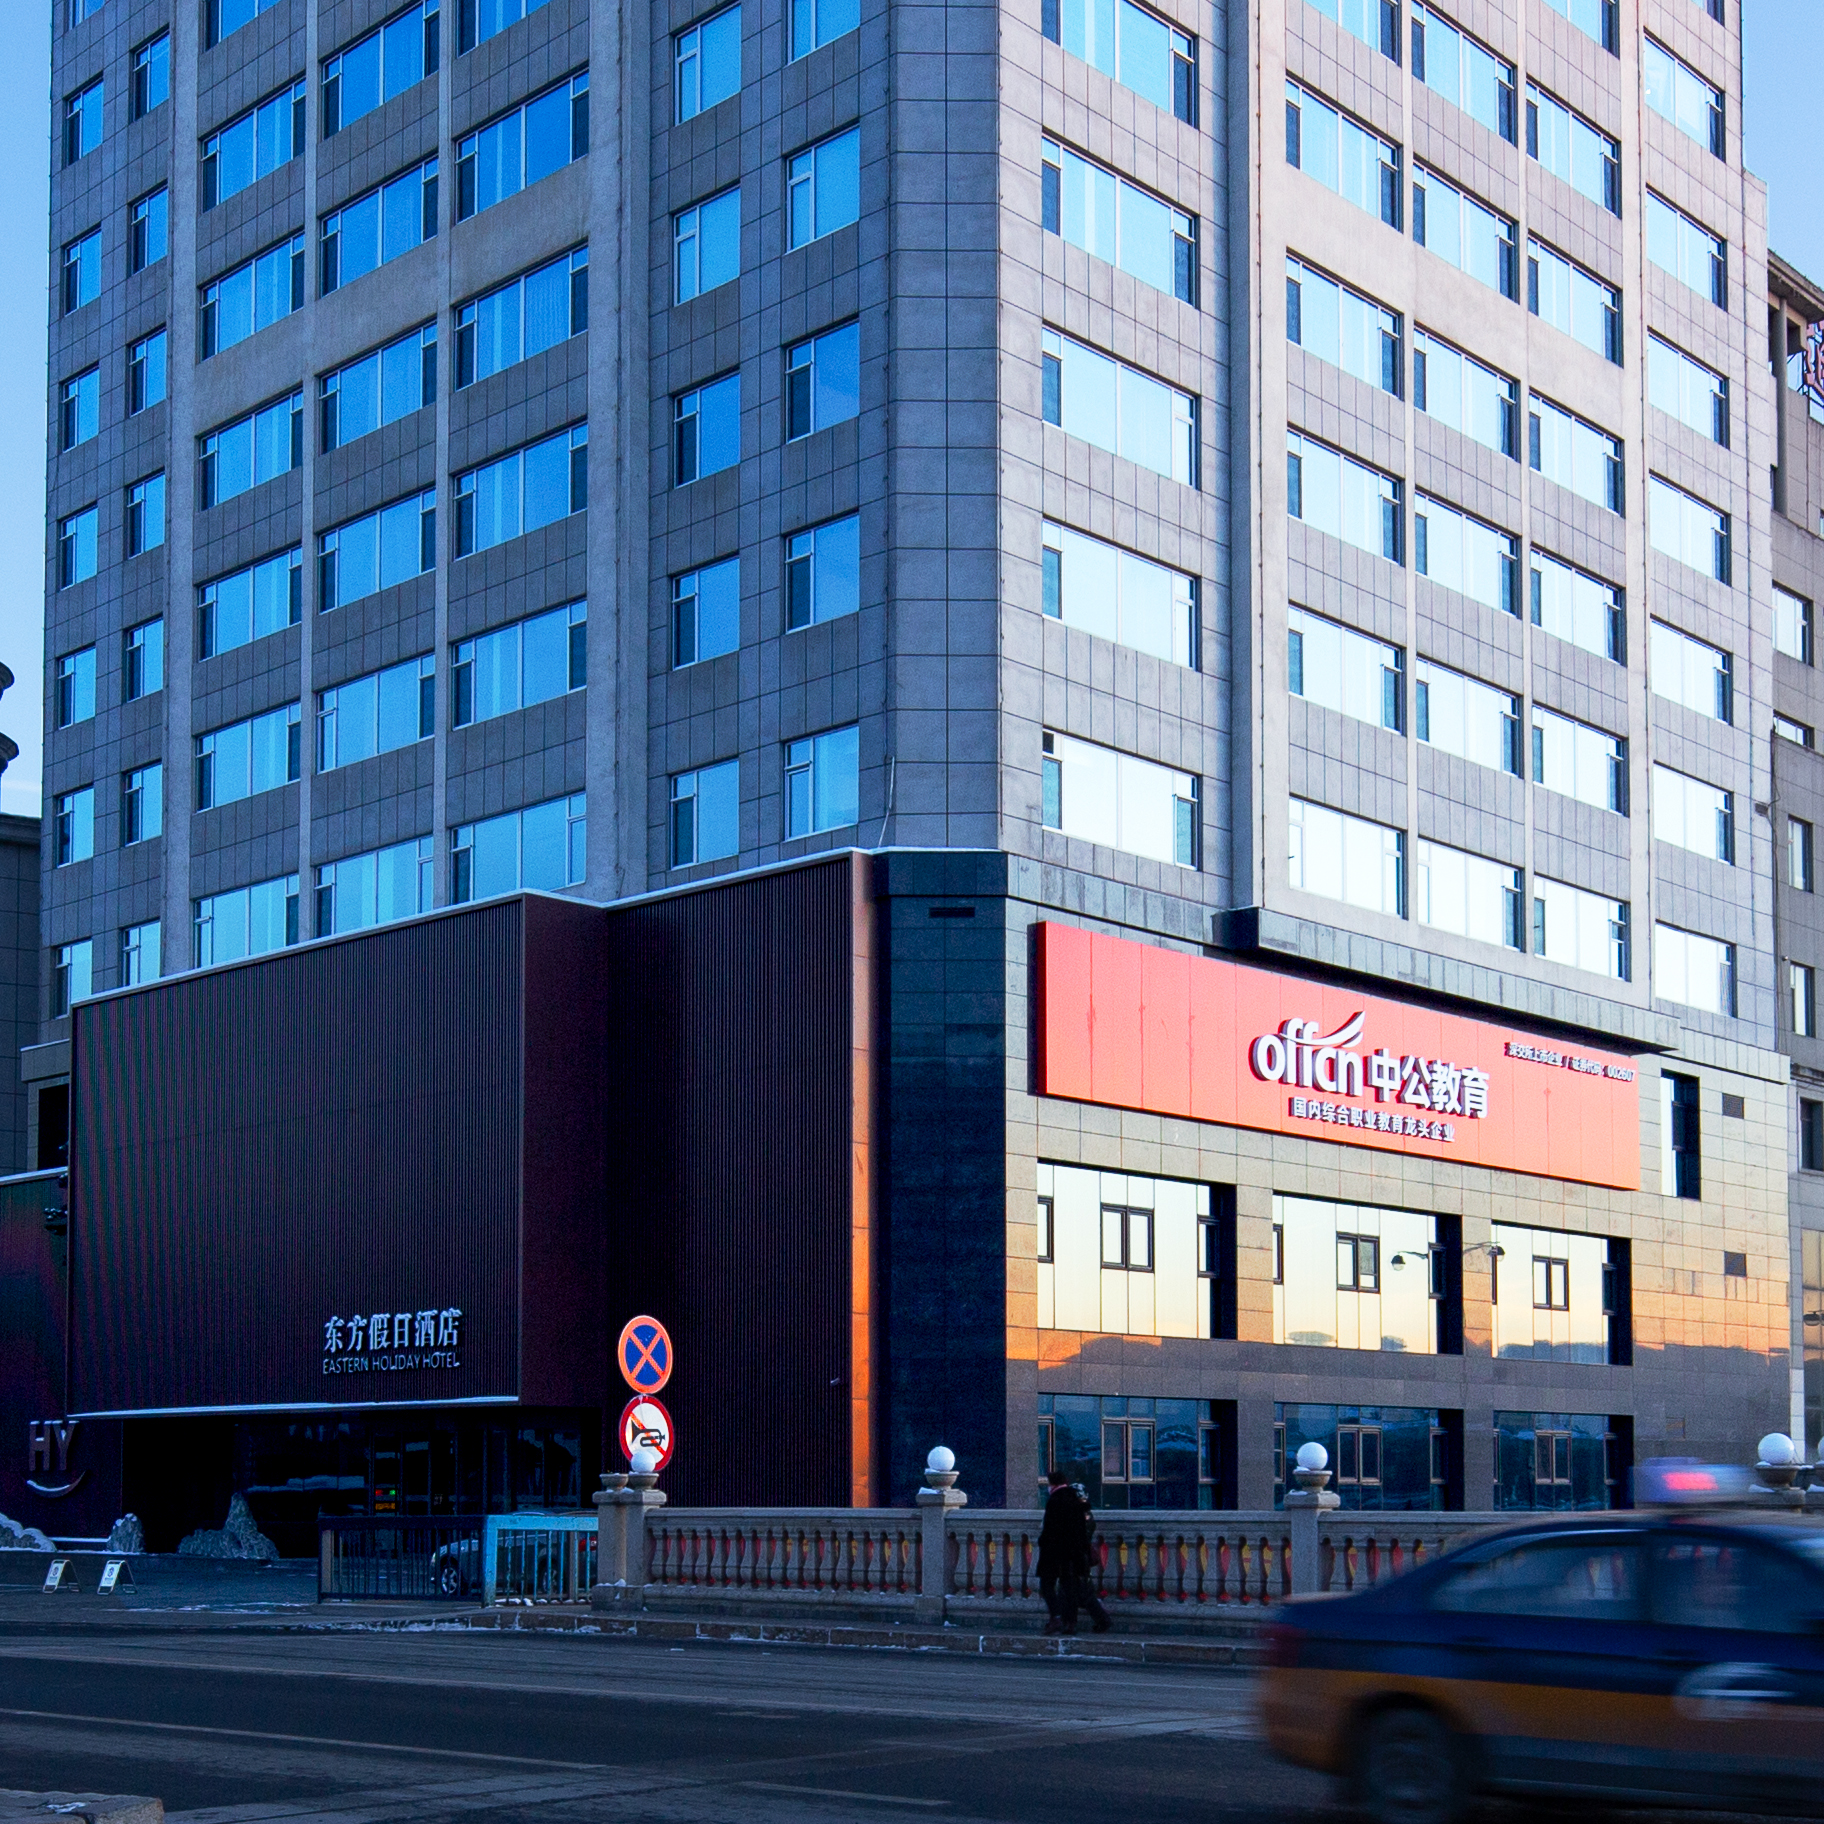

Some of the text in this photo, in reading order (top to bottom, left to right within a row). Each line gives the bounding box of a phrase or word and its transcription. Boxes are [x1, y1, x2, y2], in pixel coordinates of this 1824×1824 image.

[1506, 1042, 1562, 1067] 深交所上市企业
[1366, 1048, 1490, 1118] 中公教育
[1290, 1097, 1455, 1142] 国内综合职业教育龙头企业
[324, 1308, 463, 1353] 东方假日酒店
[323, 1351, 461, 1374] EASTERN HOLIDAY HOTEL
[28, 1420, 80, 1472] HY
